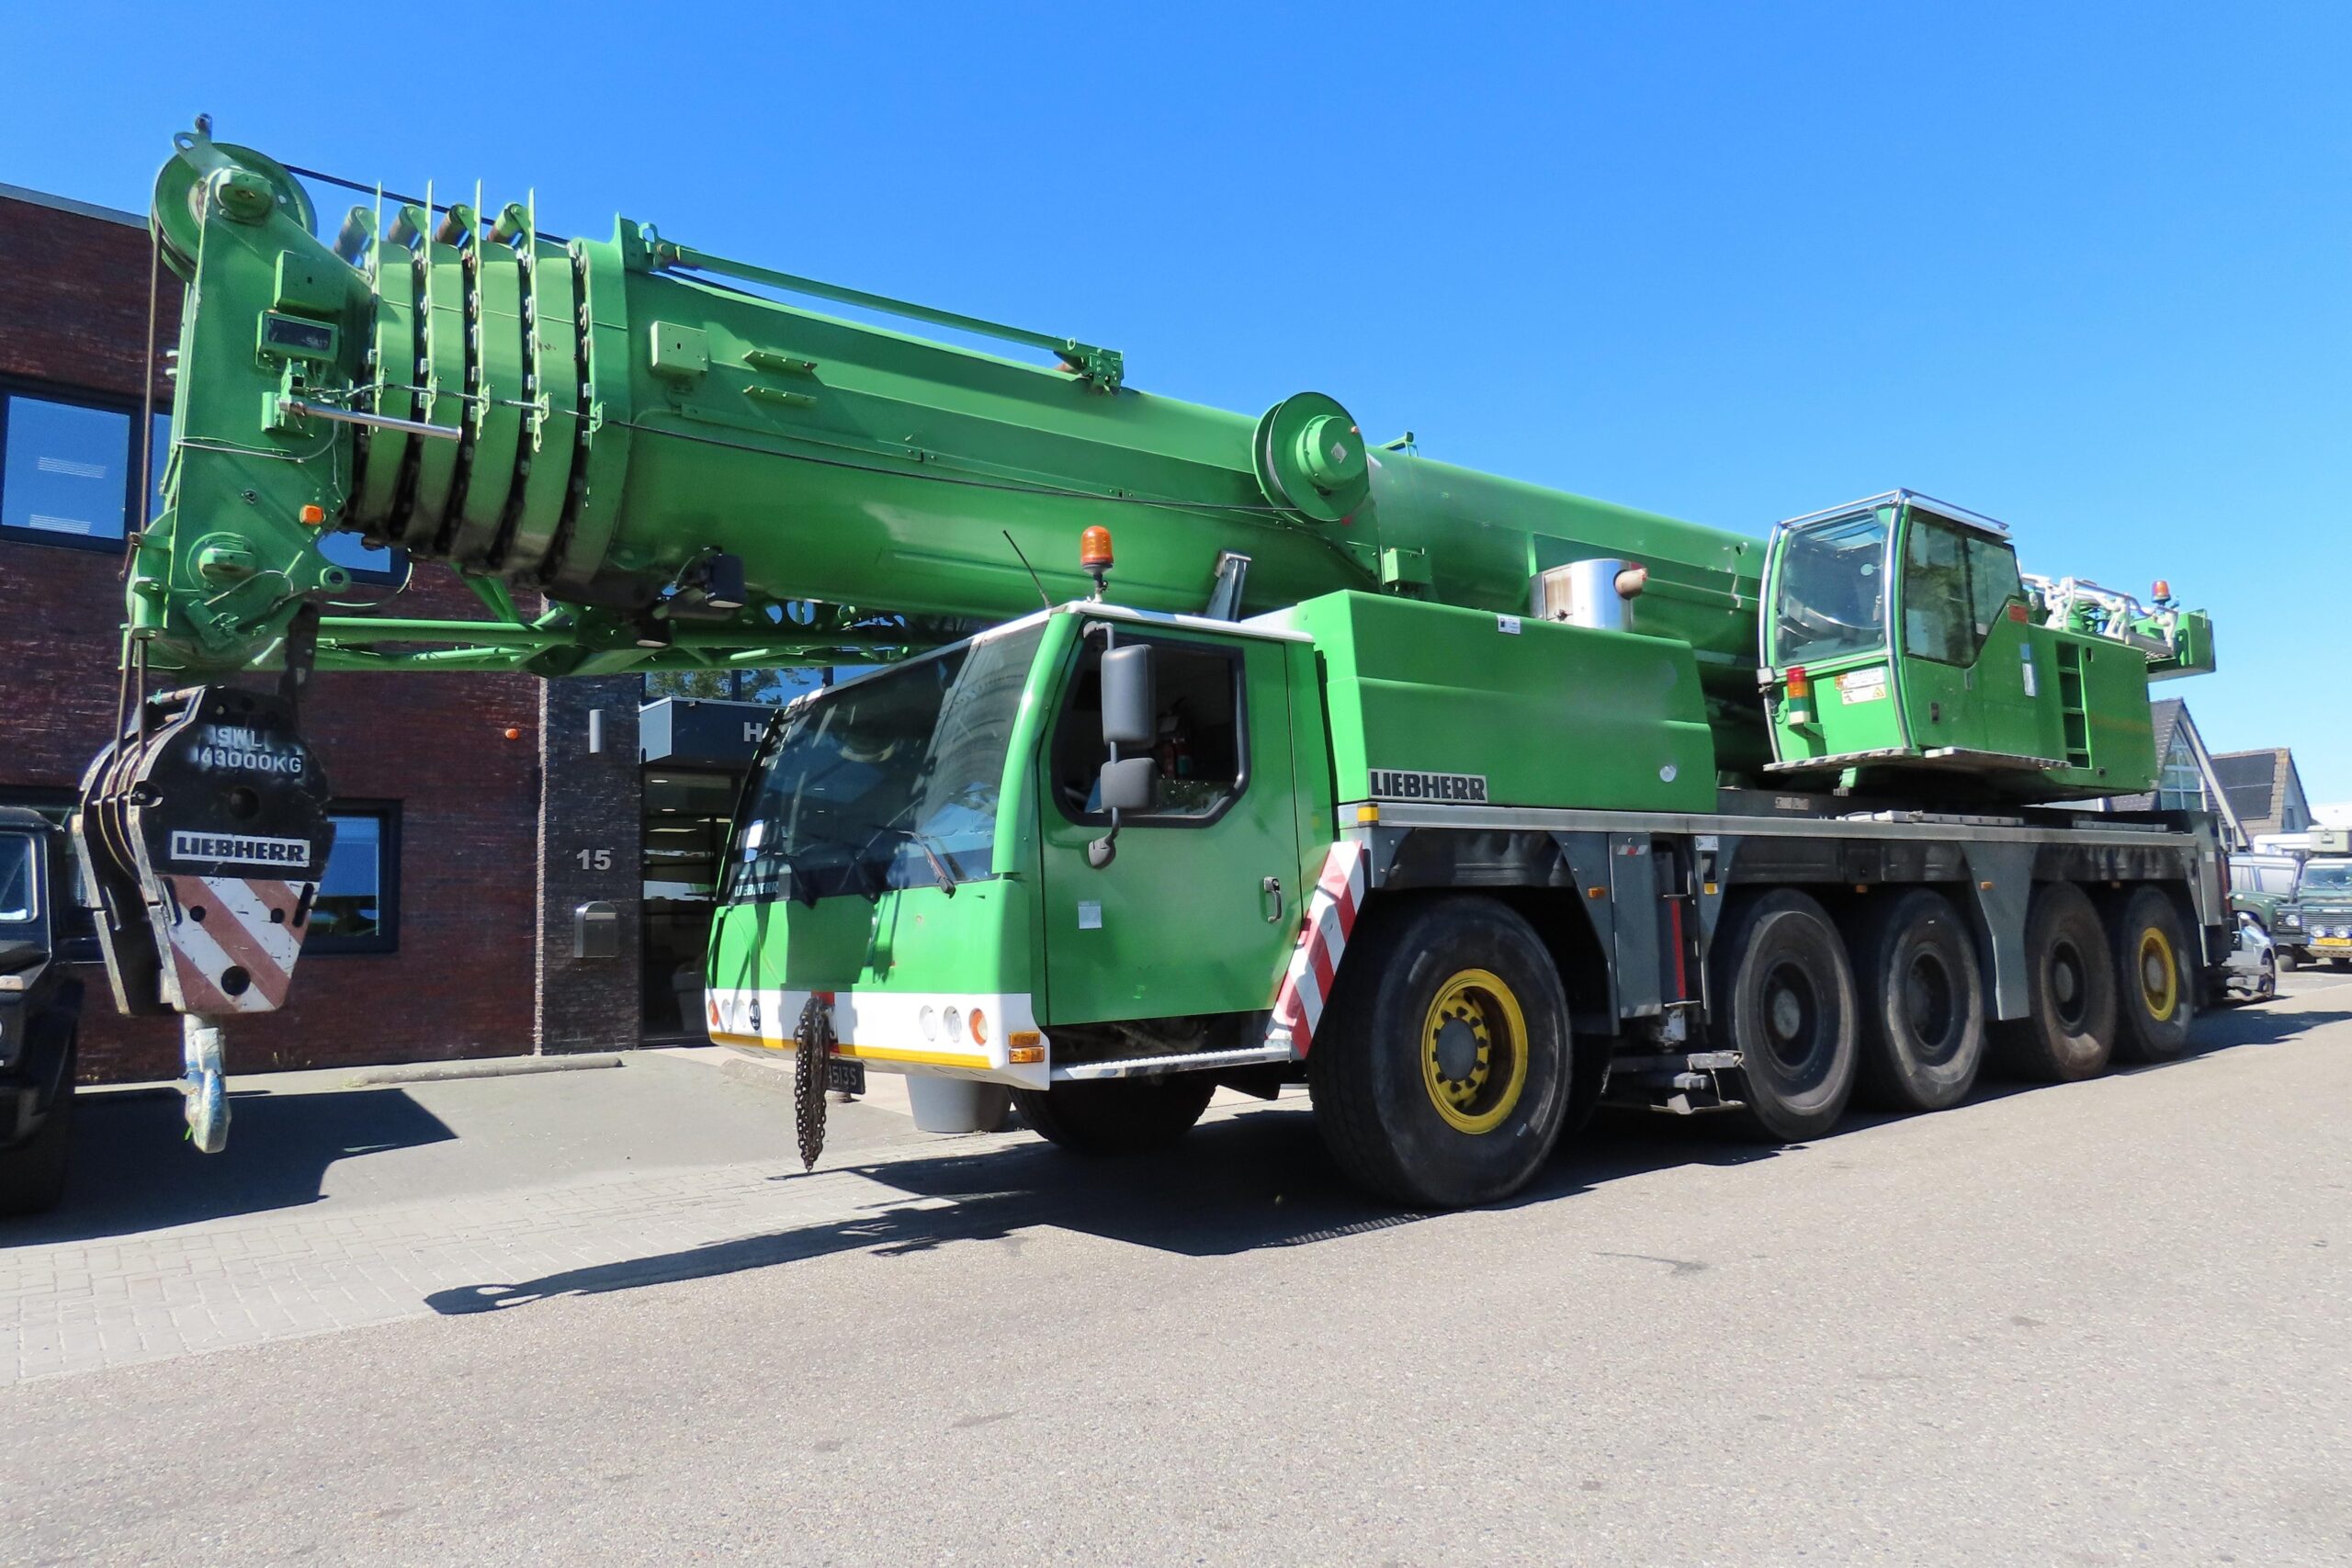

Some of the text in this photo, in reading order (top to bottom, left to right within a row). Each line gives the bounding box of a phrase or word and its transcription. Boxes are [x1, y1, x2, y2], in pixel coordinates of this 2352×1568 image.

[218, 728, 263, 749] SWL
[743, 721, 763, 743] H
[1371, 771, 1486, 801] LIEBHERR
[176, 836, 305, 863] LIEBHERR
[576, 849, 612, 871] 15
[750, 1004, 760, 1021] 40
